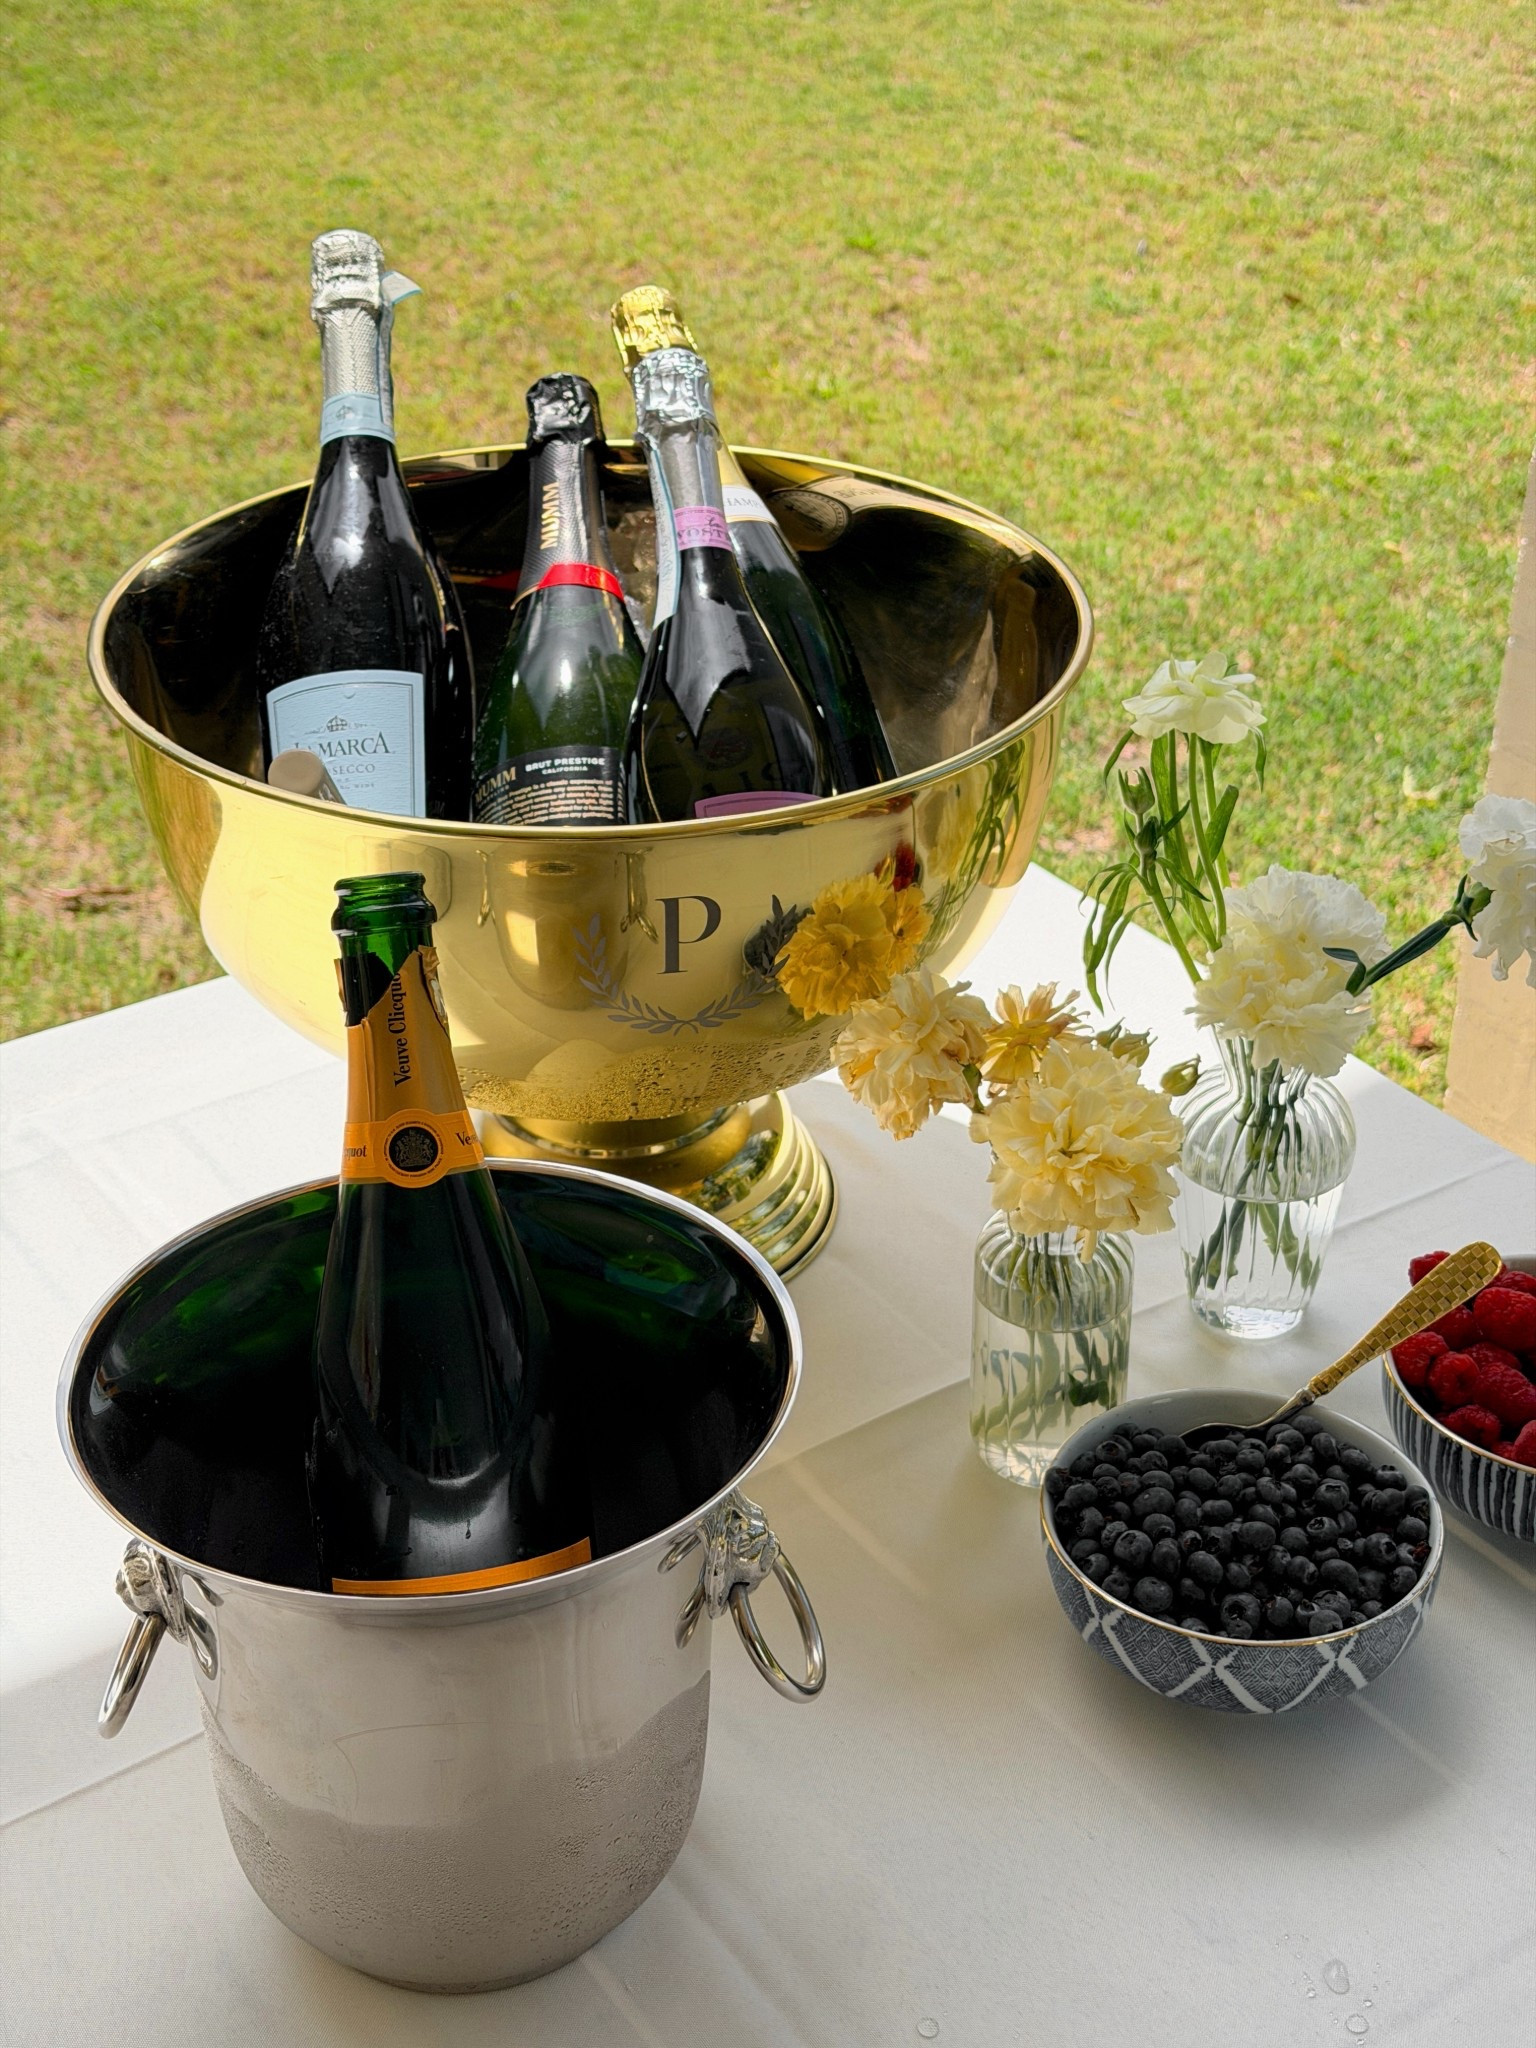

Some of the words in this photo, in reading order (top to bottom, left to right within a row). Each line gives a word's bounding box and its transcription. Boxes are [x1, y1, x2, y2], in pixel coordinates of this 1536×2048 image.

[540, 481, 560, 550] MUMM
[318, 731, 390, 757] MARCA
[331, 763, 376, 776] SECCO
[525, 759, 552, 772] BRUT
[554, 757, 605, 766] PRESTIGE
[541, 766, 588, 775] CALIFORNIA
[475, 766, 516, 803] MUMM
[655, 895, 722, 975] P
[387, 972, 407, 1034] Clicquo
[393, 1037, 412, 1088] Veuve
